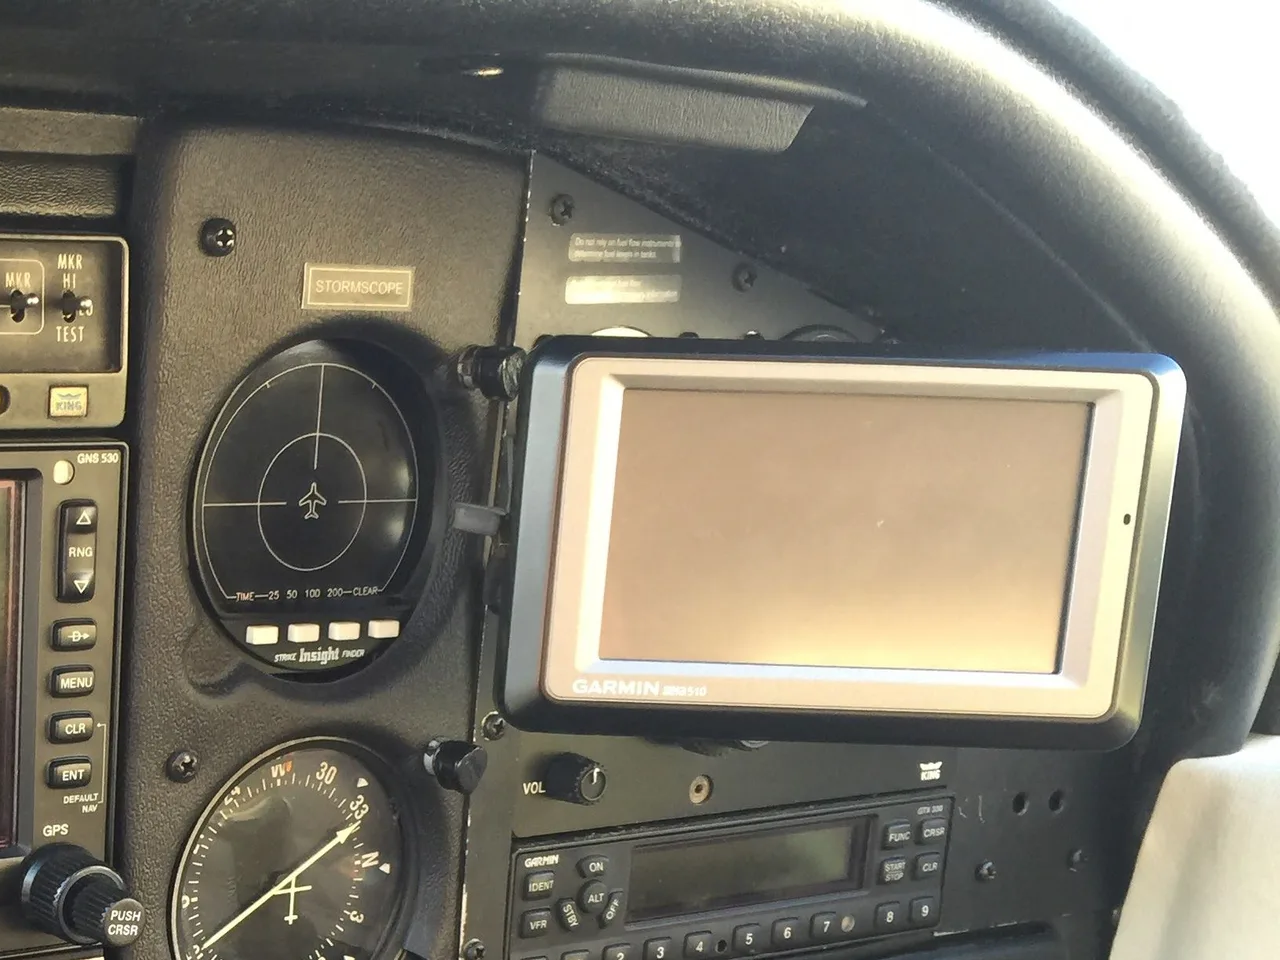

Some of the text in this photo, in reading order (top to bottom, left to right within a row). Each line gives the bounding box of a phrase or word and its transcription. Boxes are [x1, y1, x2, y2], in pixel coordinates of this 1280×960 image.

[57, 253, 83, 270] MKR
[315, 279, 404, 296] STORMSCOPE
[56, 326, 84, 343] TEST
[68, 546, 93, 558] RNG
[236, 586, 378, 601] TIME 25 50 100 200 CLEAR
[299, 646, 340, 665] Insight
[60, 676, 93, 689] MENU
[572, 678, 660, 696] GARMIN
[65, 722, 86, 735] CLR
[62, 769, 85, 781] ENT
[523, 782, 546, 795] VOL
[63, 792, 99, 805] DEFAULT
[43, 824, 69, 837] GPS
[888, 831, 911, 842] FUNC
[923, 827, 945, 838] CRSR
[528, 879, 554, 892] IDENT
[109, 909, 142, 925] PUSH
[107, 922, 139, 938] CRSR
